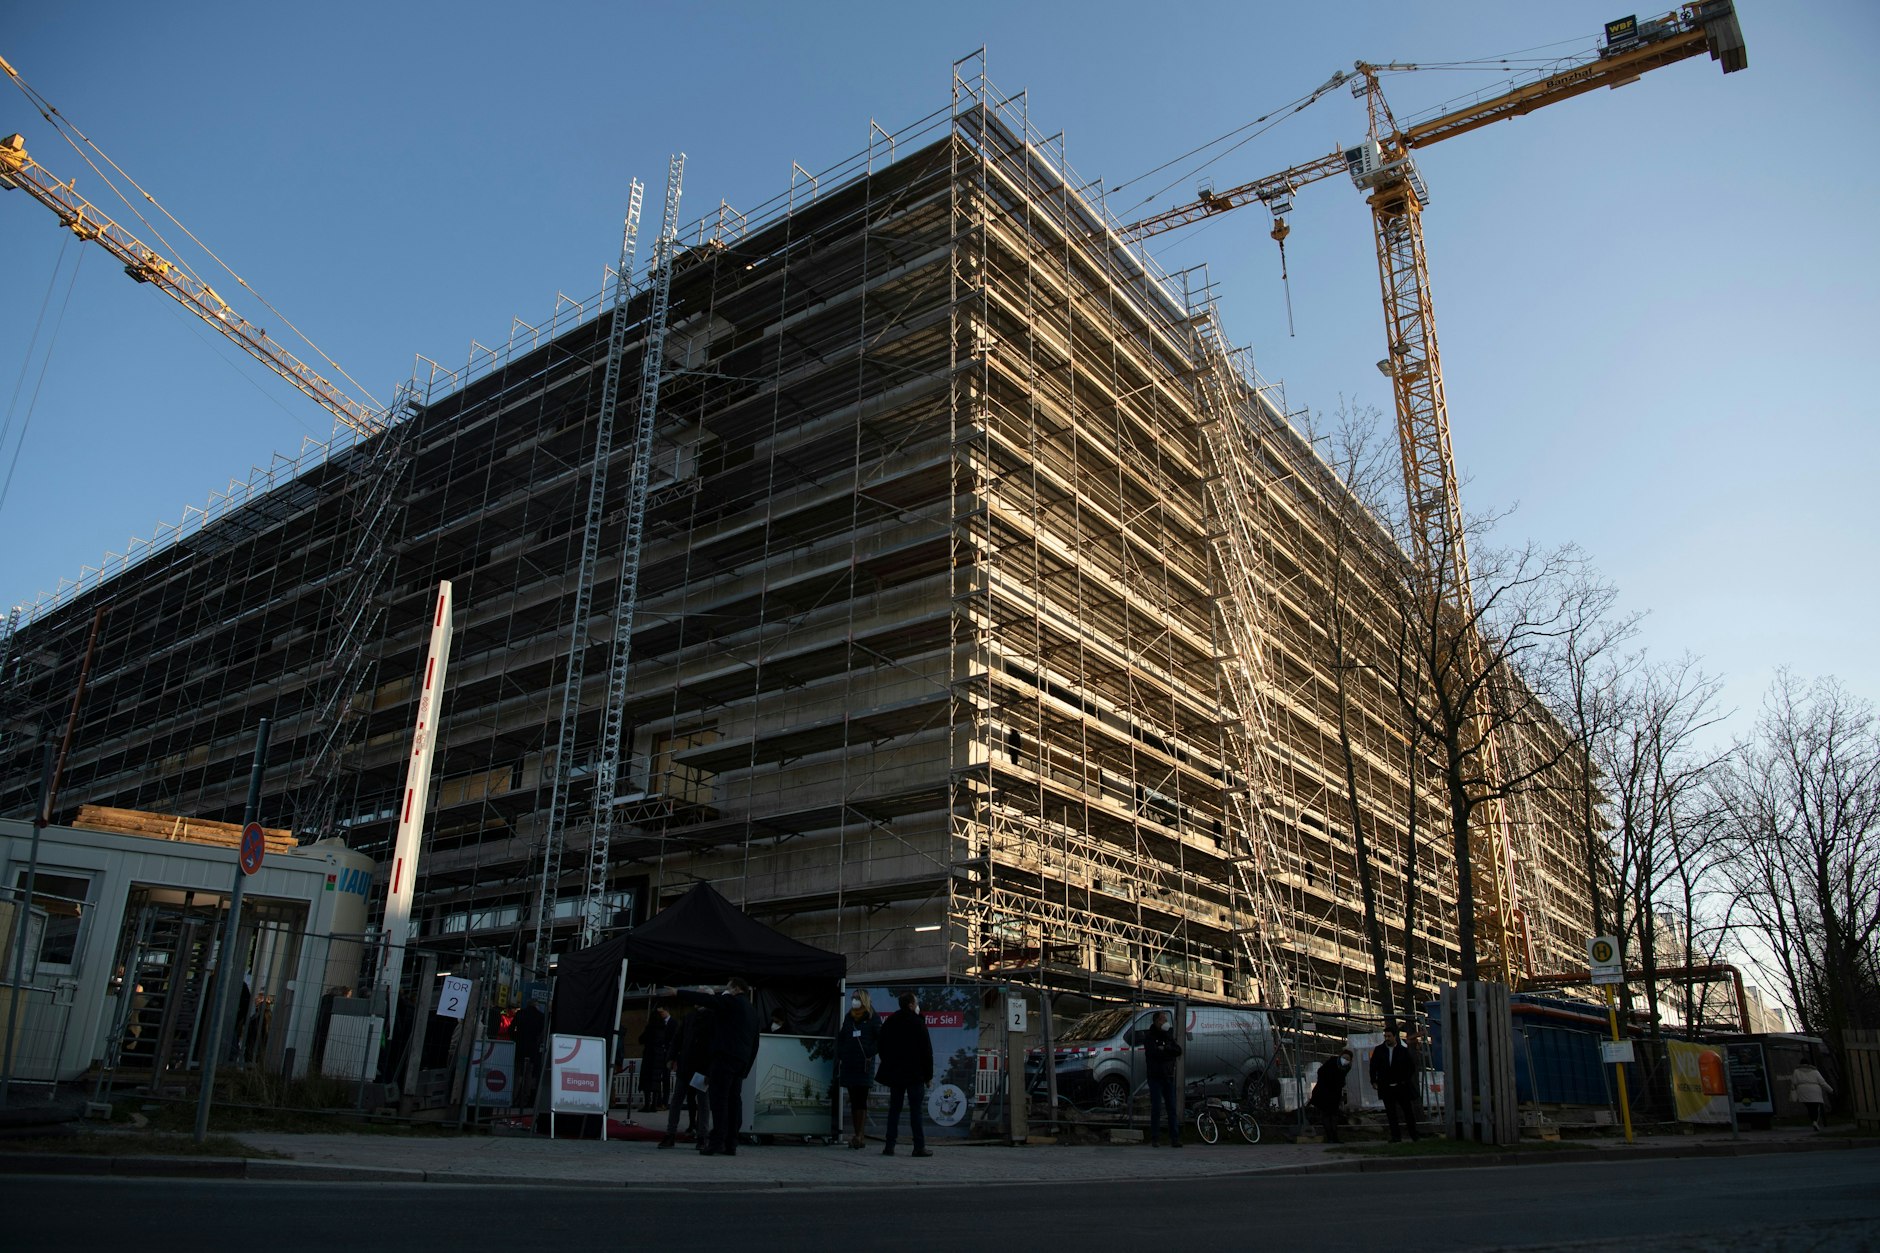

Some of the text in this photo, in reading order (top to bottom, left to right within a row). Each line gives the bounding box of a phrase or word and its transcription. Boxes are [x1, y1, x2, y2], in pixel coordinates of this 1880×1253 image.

[1609, 20, 1633, 33] WBF
[1546, 67, 1593, 88] Banzhaf
[1363, 145, 1372, 172] BANZHAF
[447, 980, 469, 992] TOR
[447, 997, 459, 1012] 2
[925, 1015, 957, 1024] für Sie!
[1014, 1014, 1021, 1025] 2
[566, 1077, 595, 1087] Eingang
